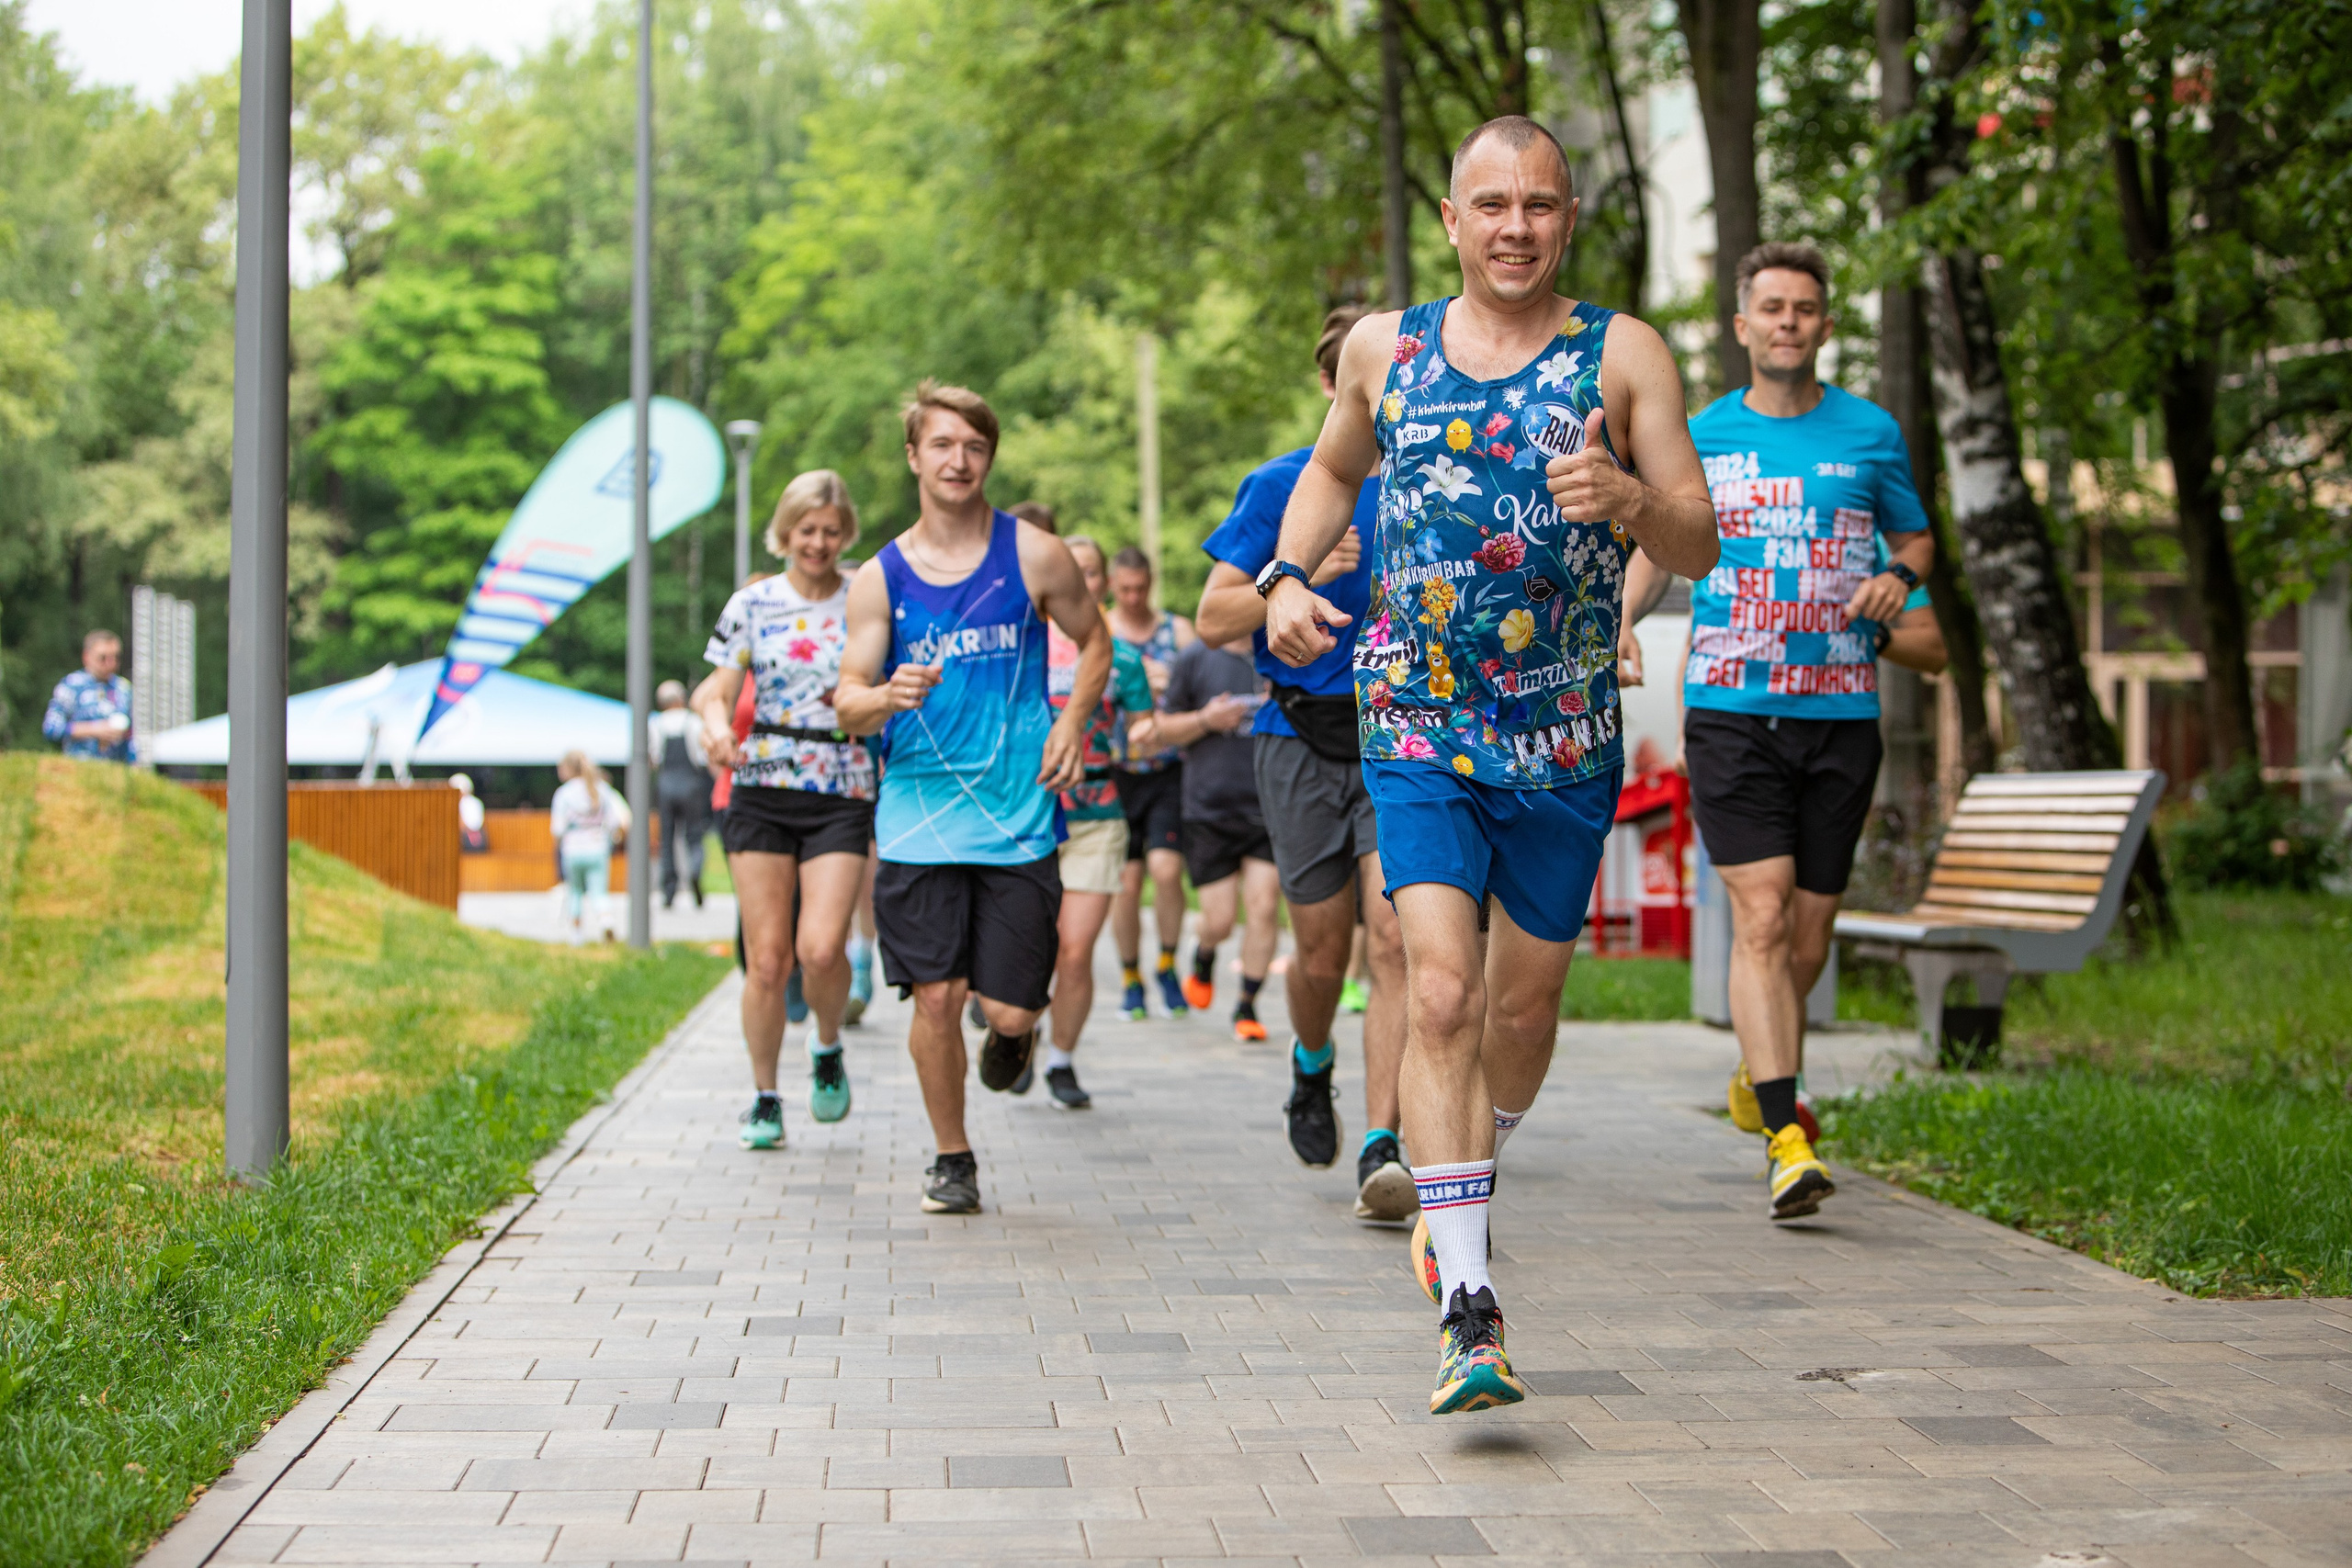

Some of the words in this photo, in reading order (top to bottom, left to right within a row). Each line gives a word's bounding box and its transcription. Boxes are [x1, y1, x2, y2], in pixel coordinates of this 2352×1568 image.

[1408, 400, 1487, 420] #khimkirunbar
[1403, 428, 1429, 442] KRB
[1418, 1184, 1463, 1201] RUN
[1467, 1180, 1491, 1196] FA
